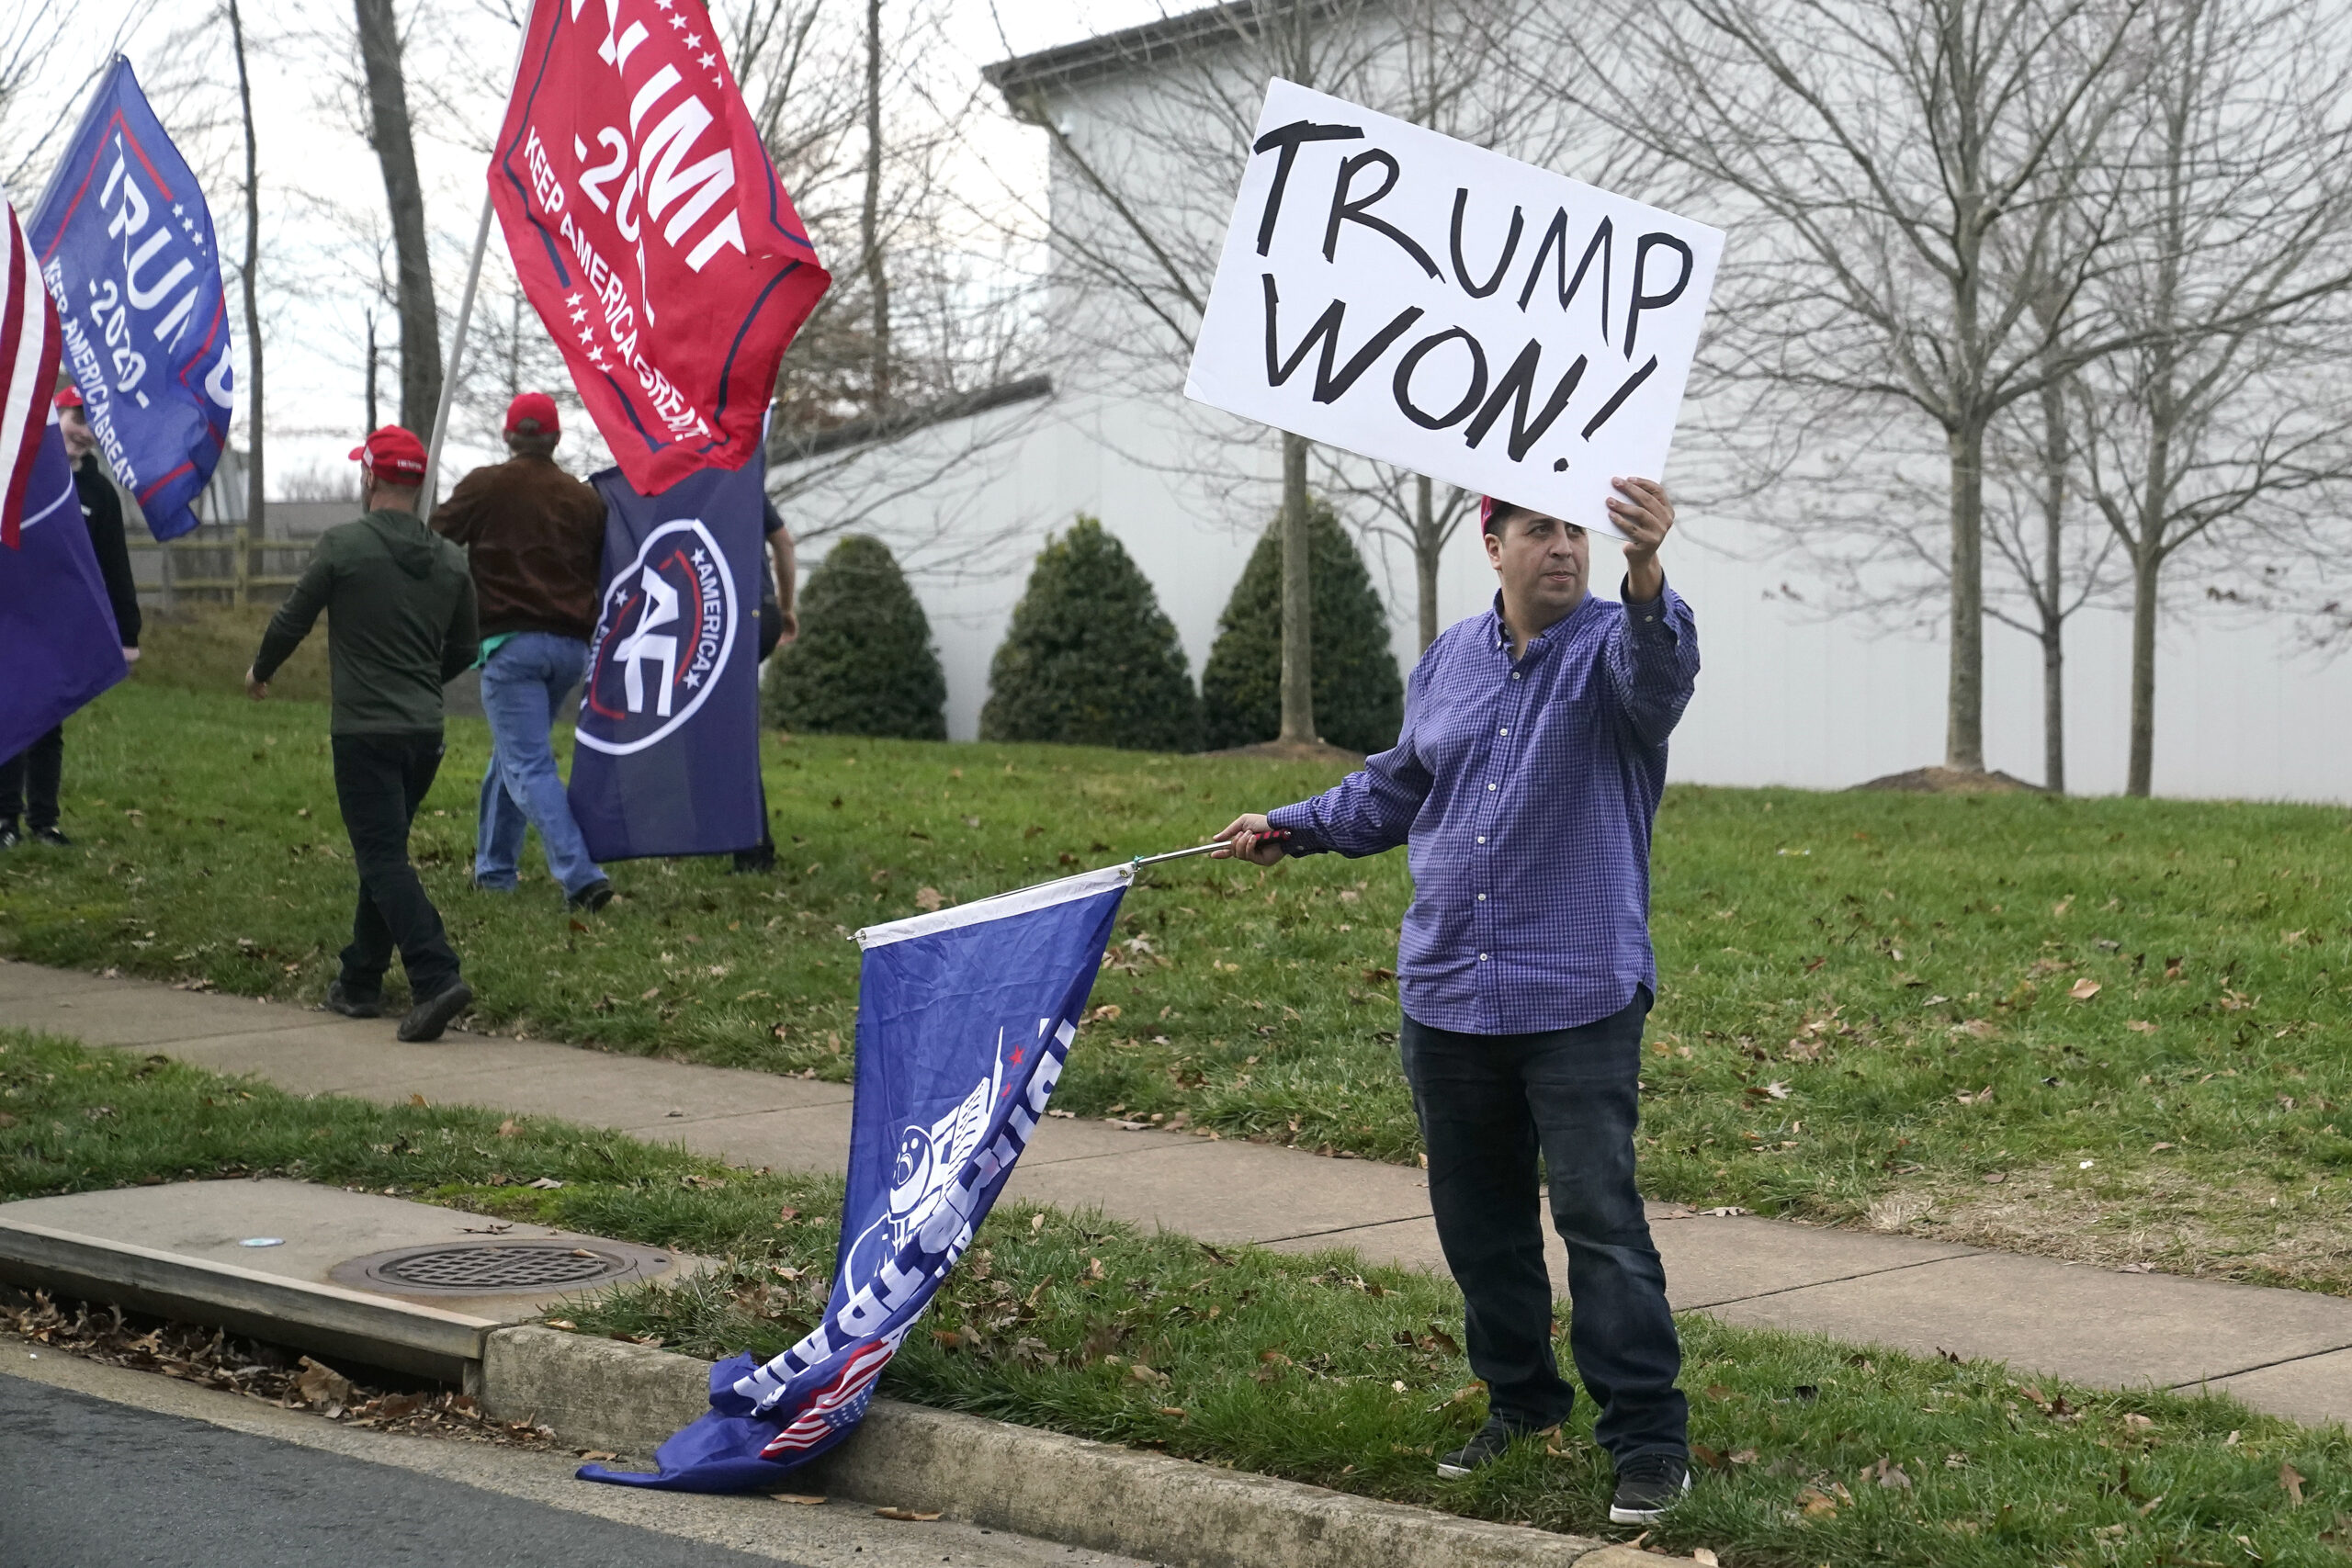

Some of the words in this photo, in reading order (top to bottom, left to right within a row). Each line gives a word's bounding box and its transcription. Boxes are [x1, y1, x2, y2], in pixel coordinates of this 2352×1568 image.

[524, 126, 564, 214] KEEP
[560, 212, 639, 367] AMERICA
[1253, 119, 1693, 361] TRUMP
[42, 255, 69, 314] KEEP
[62, 317, 109, 422] AMERICA
[95, 413, 139, 491] GREAT!
[1262, 274, 1657, 472] WON!
[692, 561, 721, 675] AMERICA
